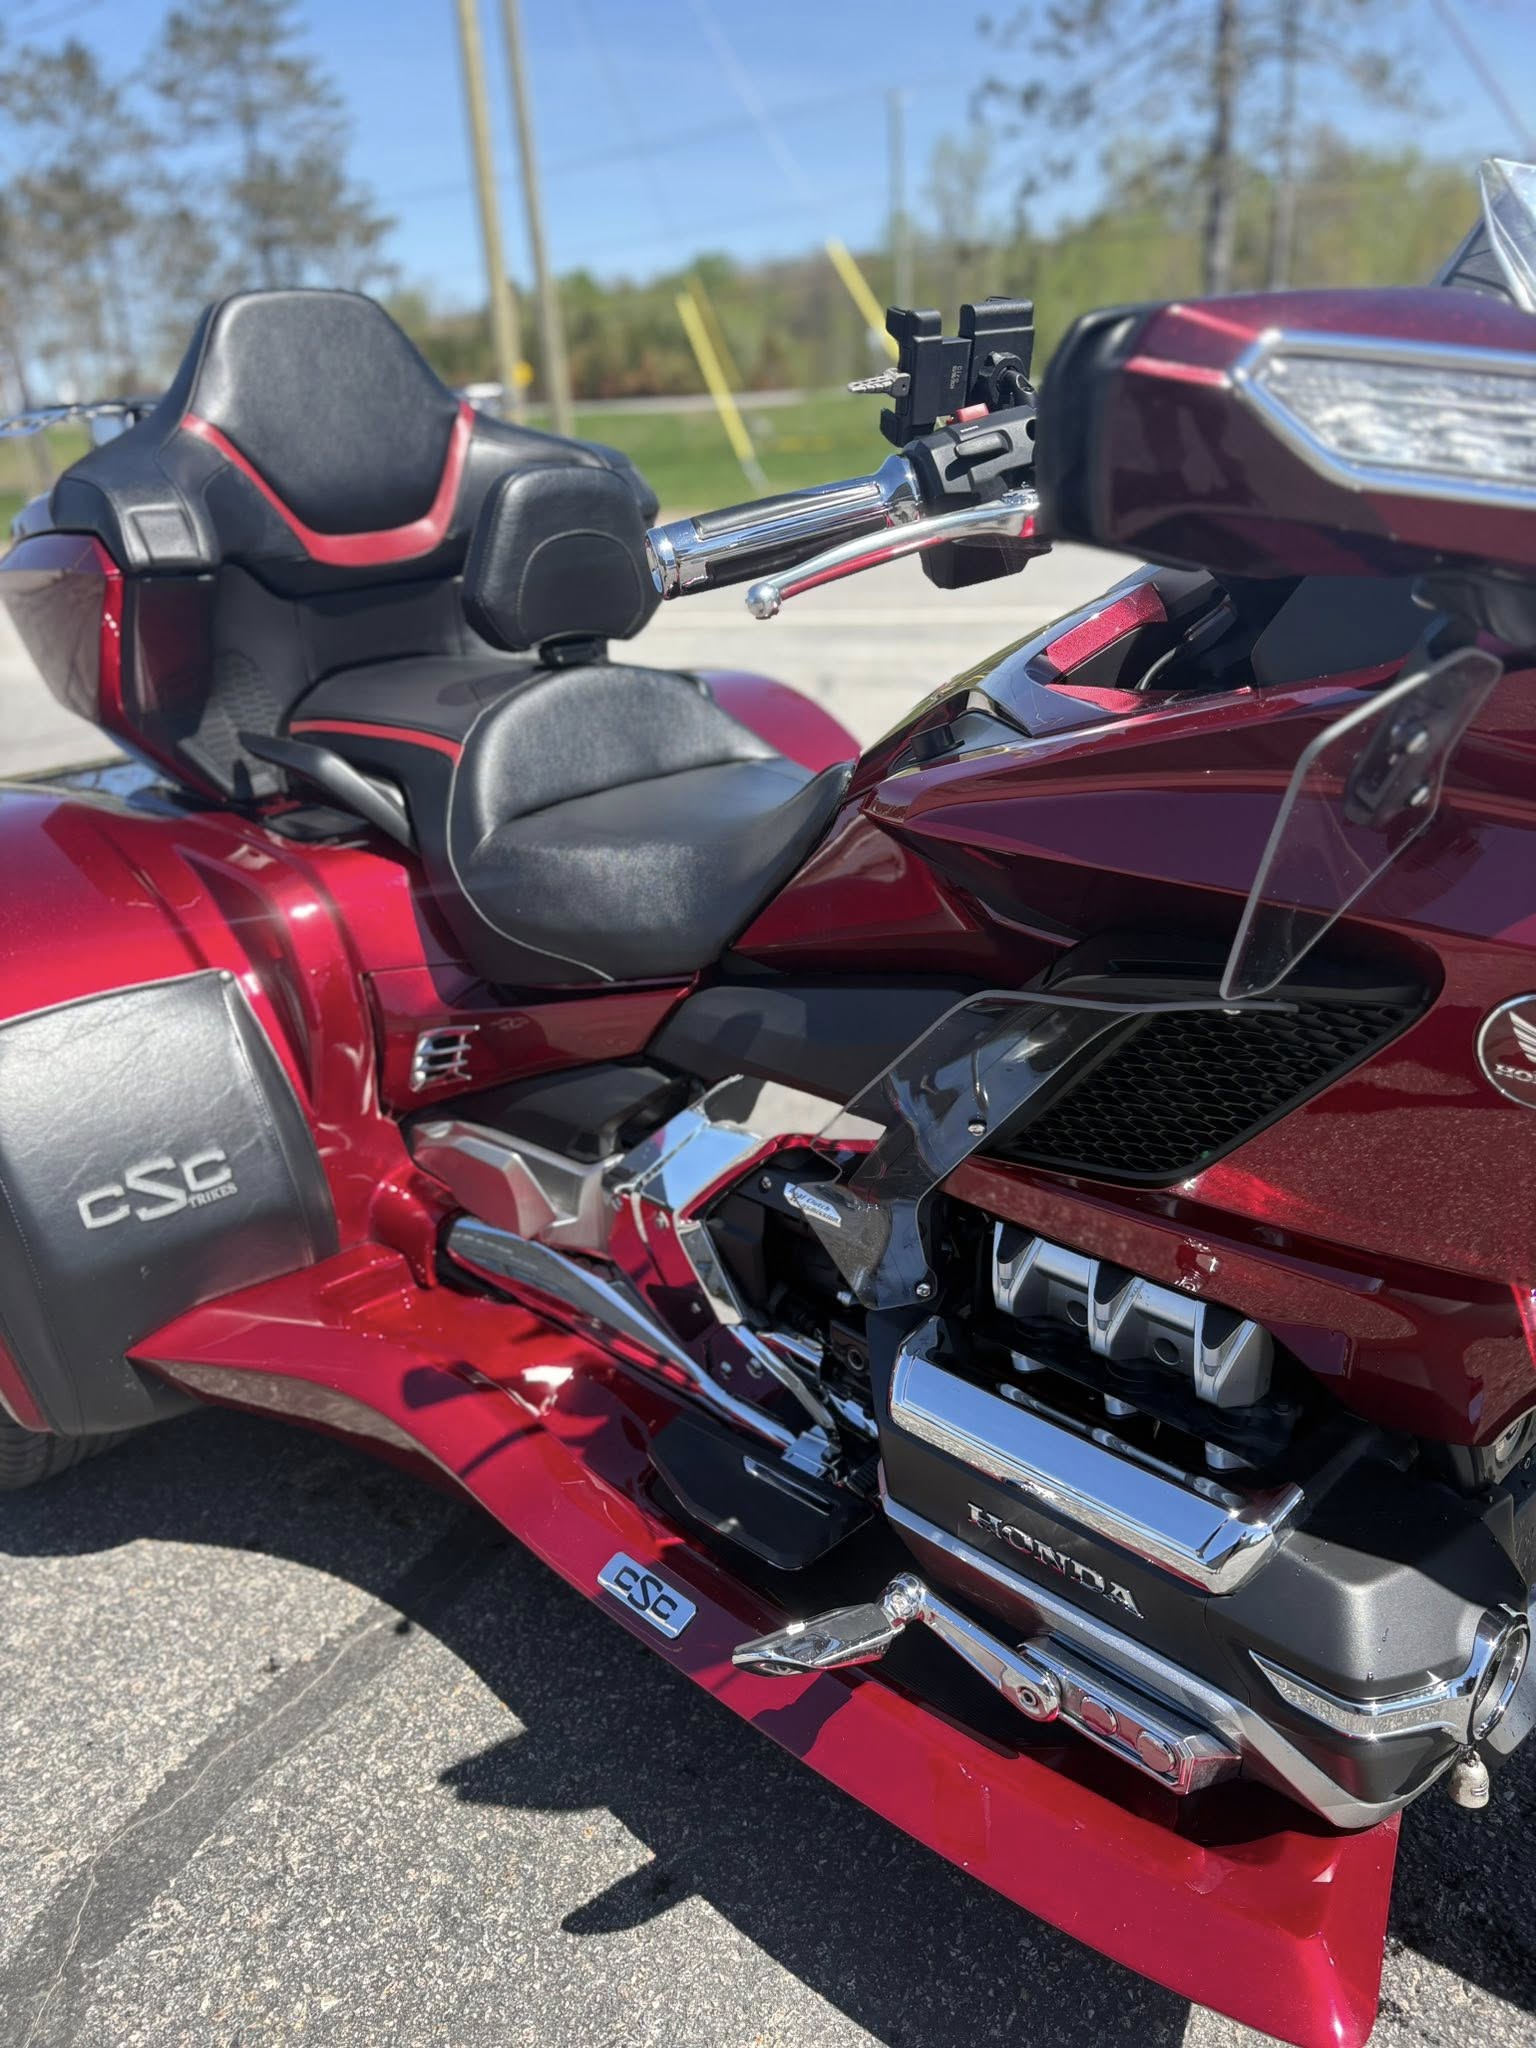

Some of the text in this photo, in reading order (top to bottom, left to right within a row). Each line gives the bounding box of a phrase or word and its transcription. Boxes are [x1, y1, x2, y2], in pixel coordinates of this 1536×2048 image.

[1494, 1063, 1536, 1084] HO
[188, 1181, 239, 1209] TRIKES
[967, 1502, 1145, 1619] HONDA
